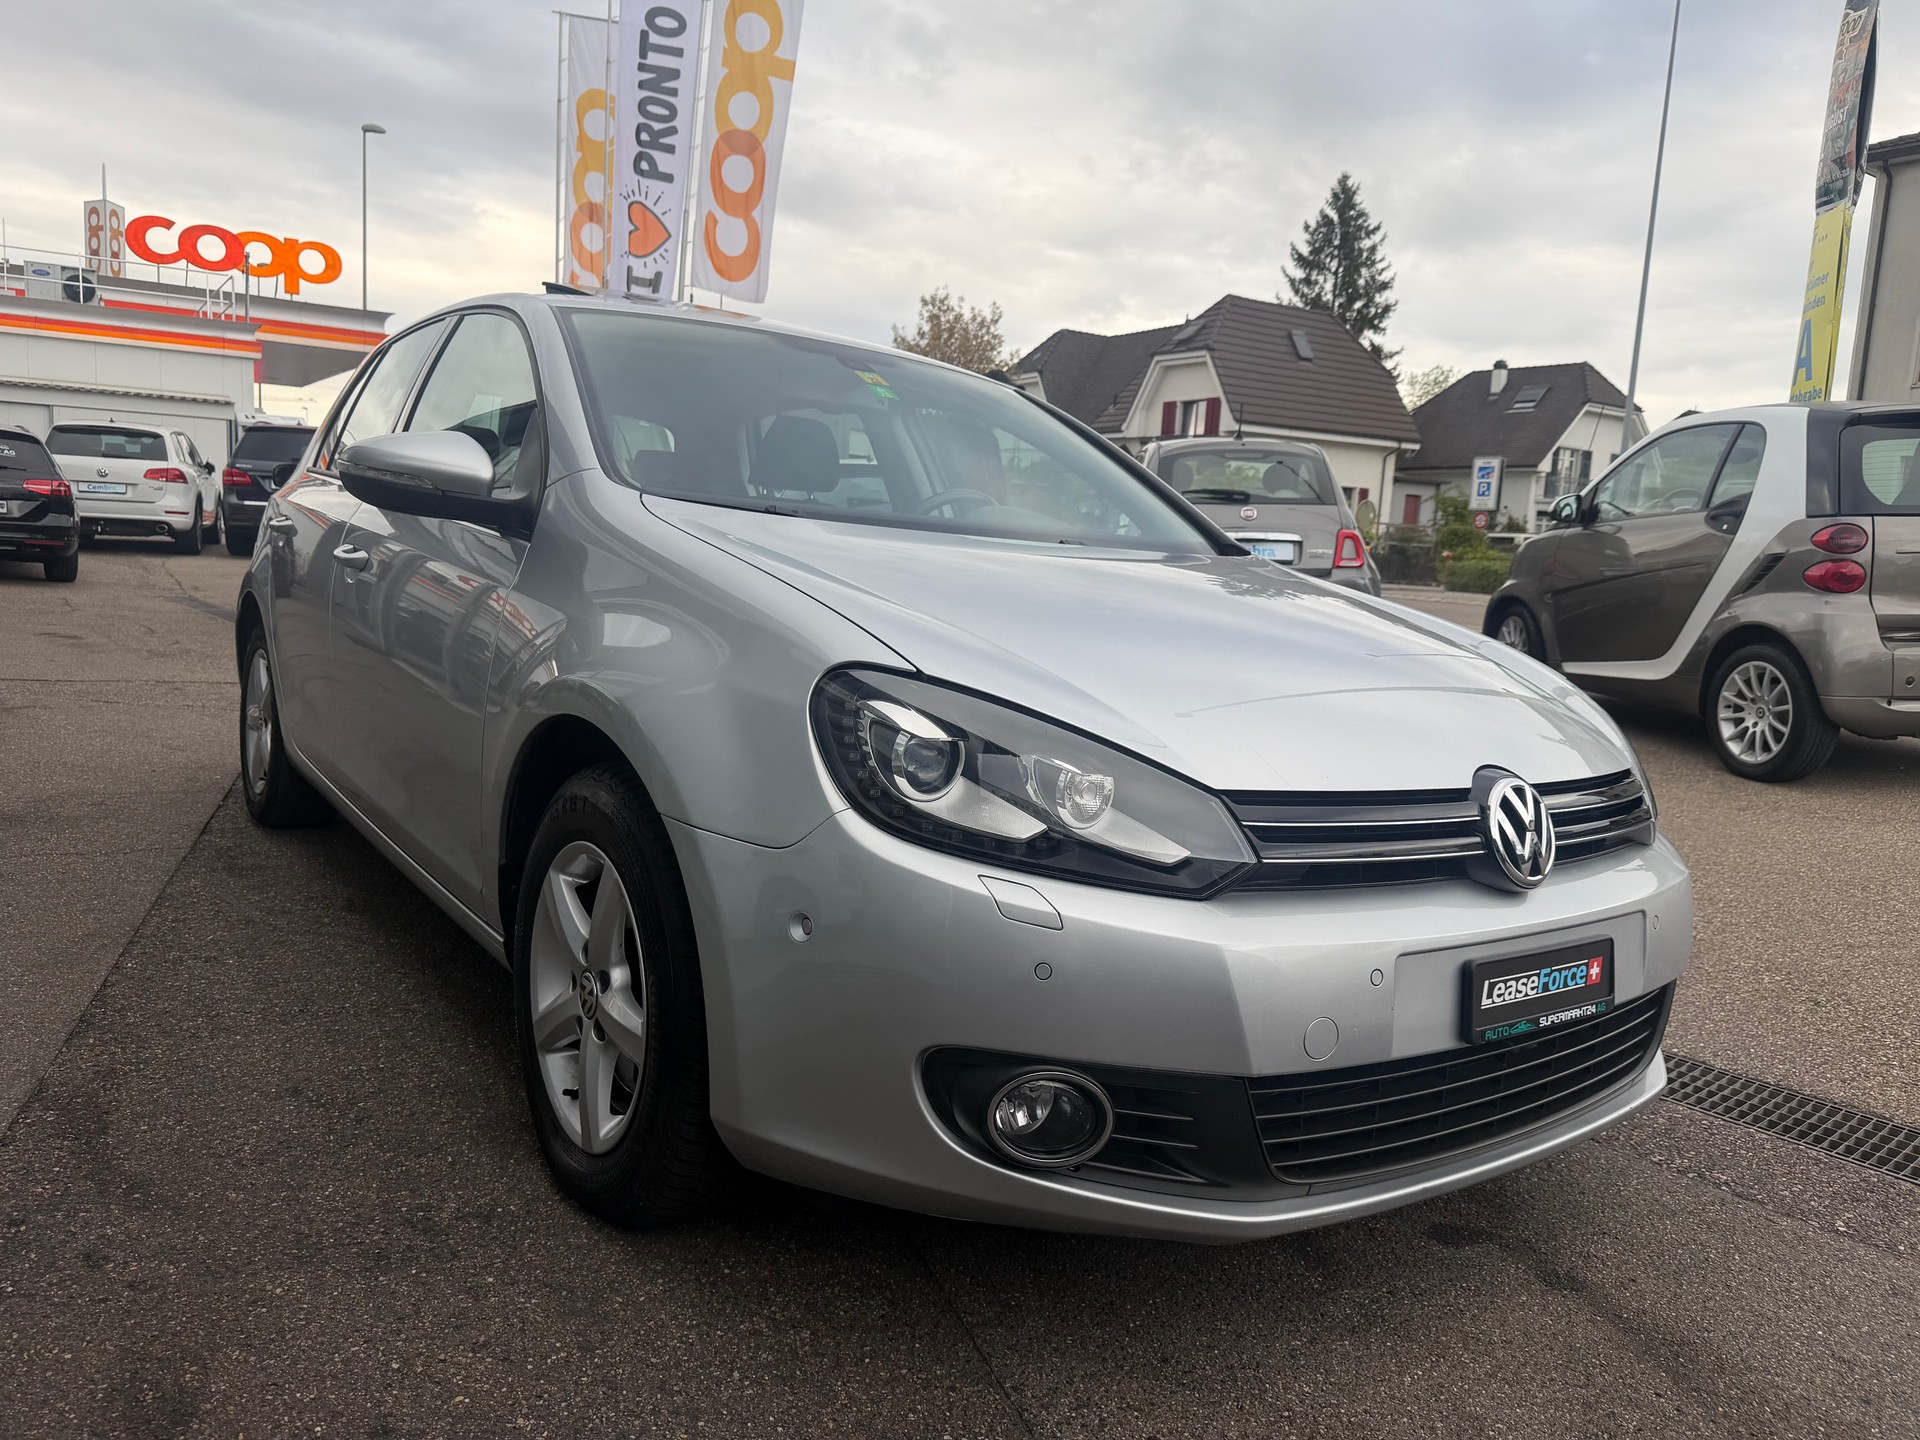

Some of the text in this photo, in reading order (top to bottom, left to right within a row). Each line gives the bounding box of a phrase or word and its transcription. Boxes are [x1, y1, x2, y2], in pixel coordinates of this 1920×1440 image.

[570, 88, 616, 285] oop
[627, 6, 688, 294] I PRONTO
[704, 0, 796, 283] coop
[125, 215, 343, 295] coop
[1481, 963, 1587, 1006] LeaseForce
[1485, 1026, 1510, 1041] AUTO
[1597, 1002, 1606, 1012] AG
